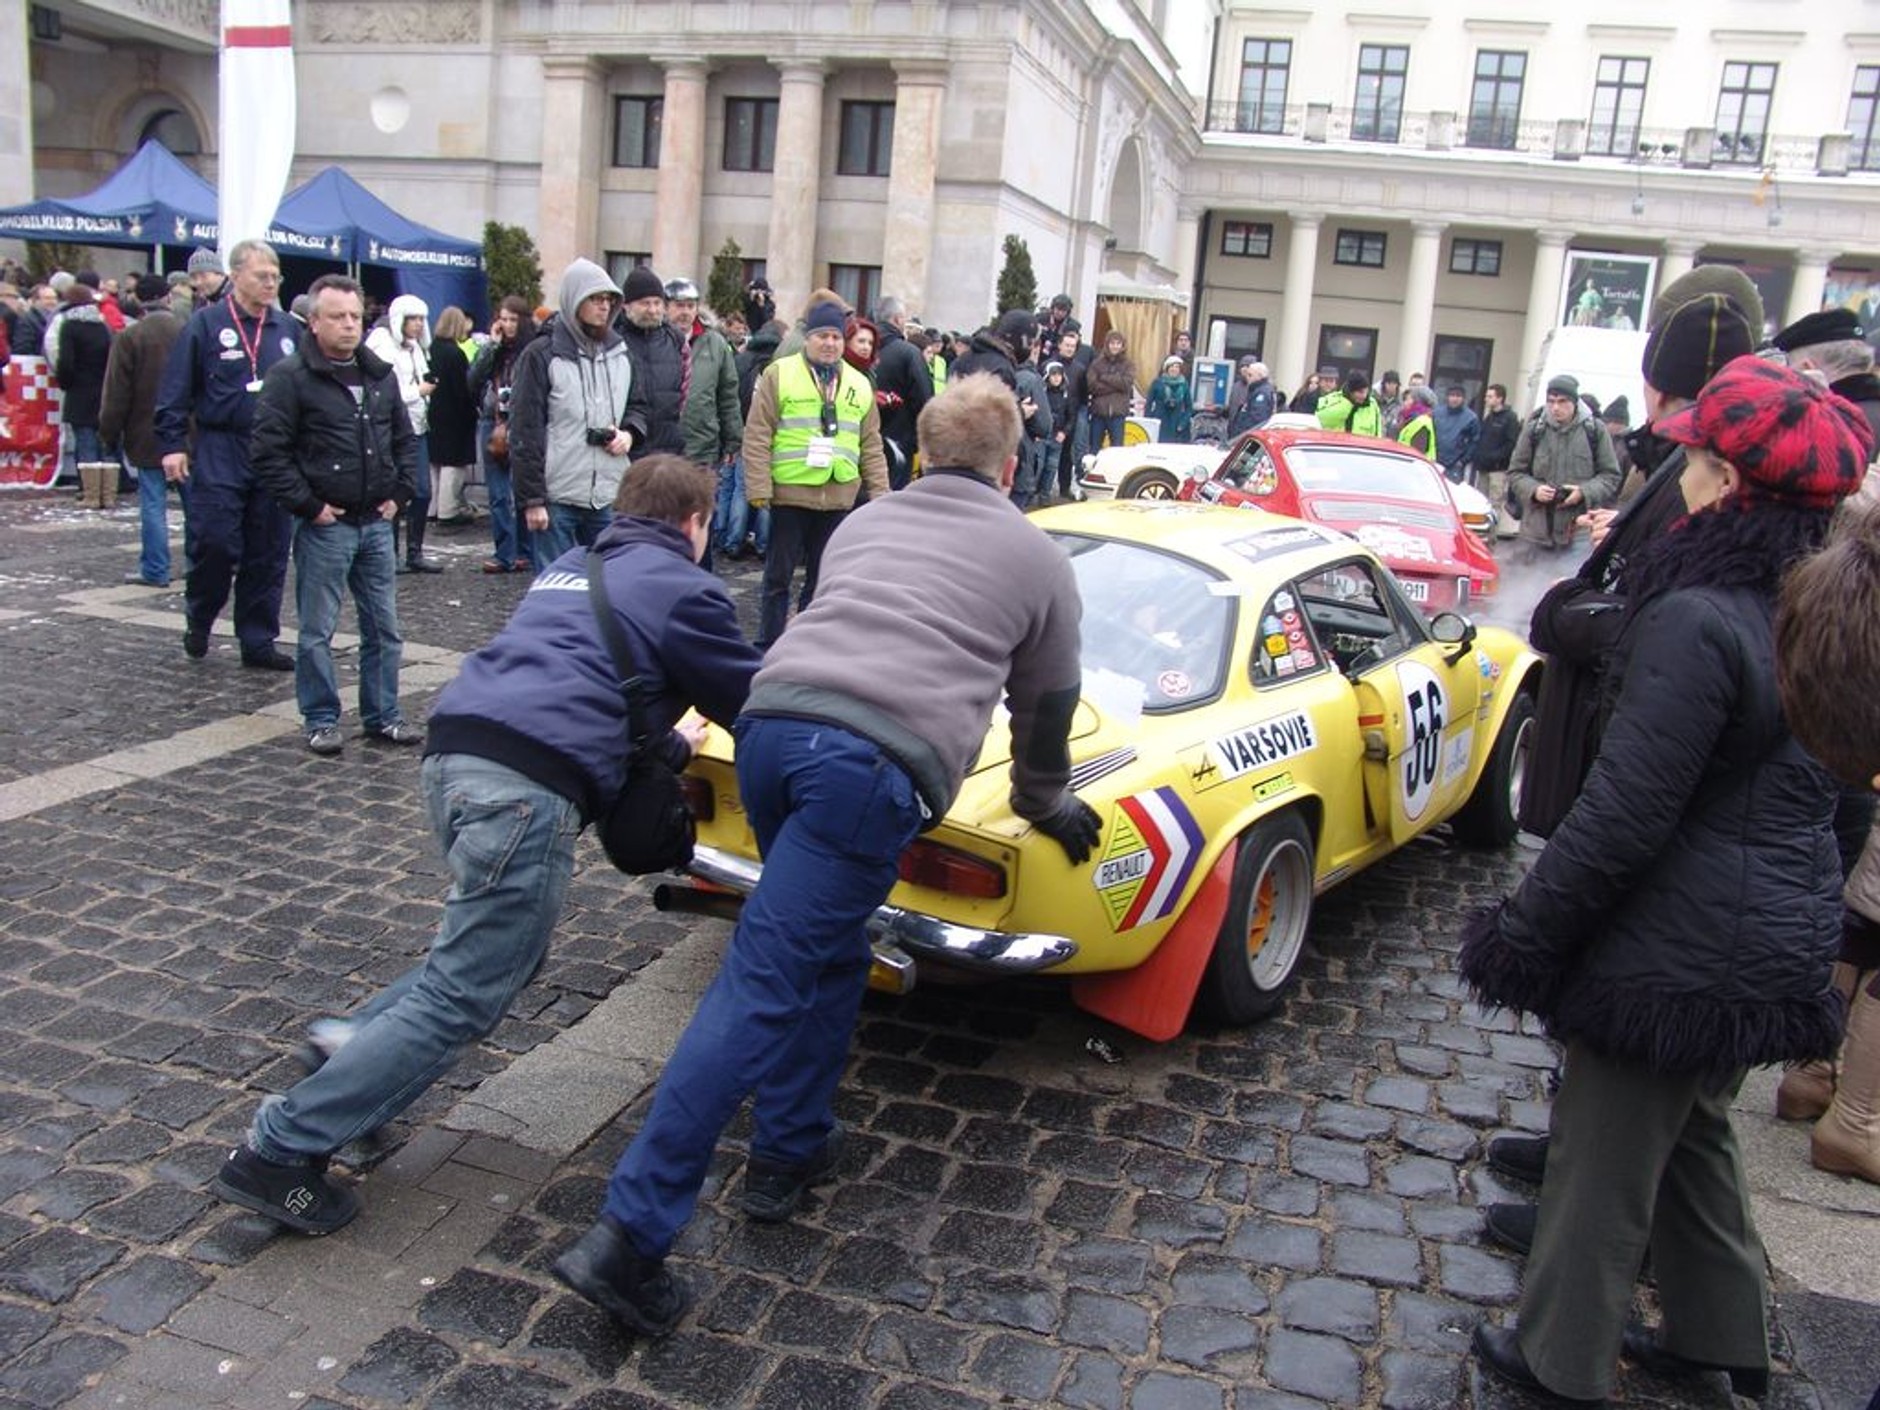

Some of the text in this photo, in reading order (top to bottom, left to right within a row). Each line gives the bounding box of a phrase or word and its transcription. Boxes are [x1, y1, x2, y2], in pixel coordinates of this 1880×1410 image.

[76, 217, 122, 231] POLSKI
[1217, 714, 1312, 772] VARSOVIE
[1406, 680, 1442, 797] 56
[1101, 852, 1146, 886] RENAULT
